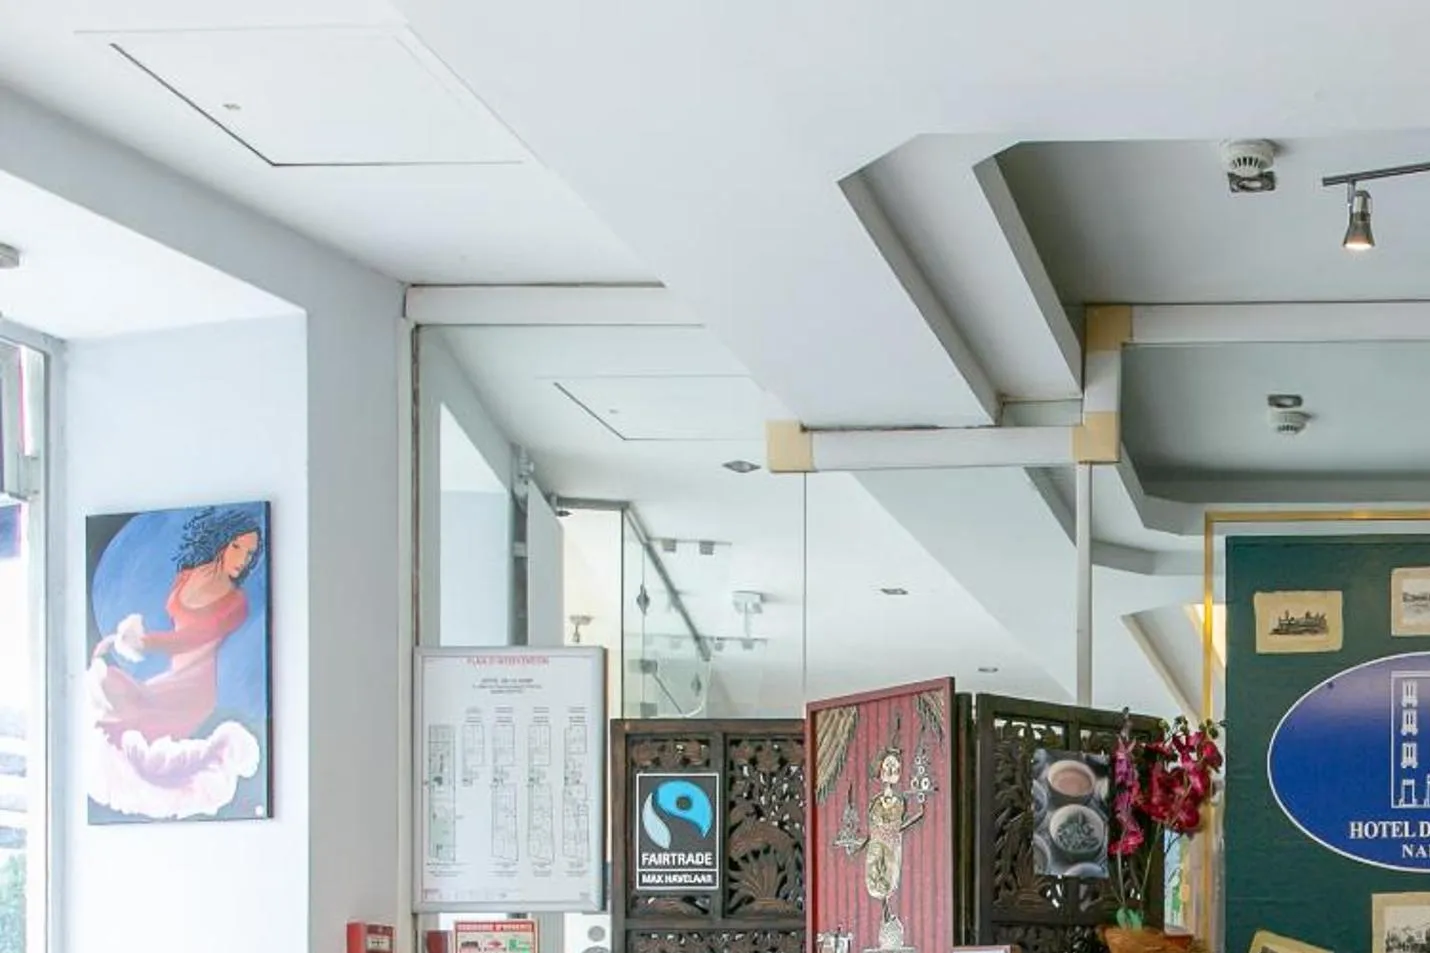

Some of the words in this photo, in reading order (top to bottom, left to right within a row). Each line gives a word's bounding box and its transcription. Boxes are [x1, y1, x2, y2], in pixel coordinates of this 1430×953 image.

[1349, 821, 1416, 839] HOTEL
[641, 852, 713, 866] FAIRTRADE
[641, 874, 663, 883] MAX
[664, 874, 713, 884] HAVELAAR
